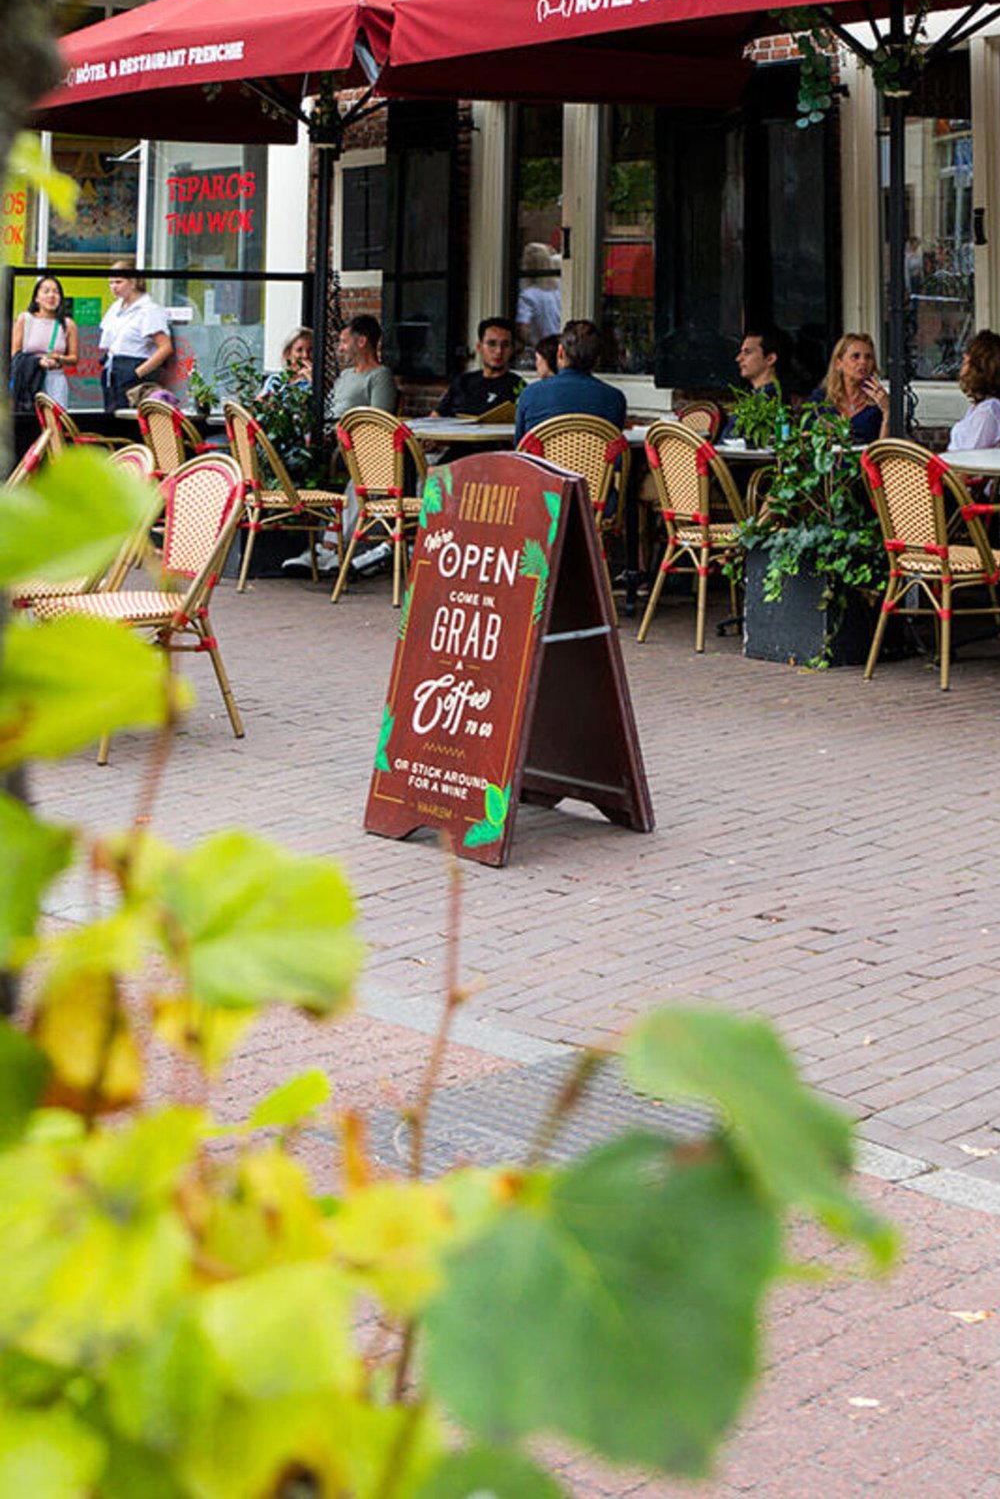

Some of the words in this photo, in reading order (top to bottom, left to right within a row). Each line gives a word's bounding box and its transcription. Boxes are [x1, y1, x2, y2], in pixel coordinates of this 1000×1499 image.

[119, 49, 187, 76] RESTAURANT
[188, 41, 245, 65] FRENCHIE
[166, 171, 256, 203] TEPAROS
[165, 212, 205, 236] THAI
[206, 209, 255, 235] WOK
[438, 542, 520, 587] OPEN
[450, 591, 480, 606] COME
[482, 596, 496, 608] IN
[431, 606, 502, 661] GRAB
[455, 660, 464, 671] A
[412, 674, 492, 736] Coffee
[464, 719, 479, 736] TO
[479, 721, 494, 738] GO
[394, 758, 410, 771] OR
[411, 762, 442, 779] STICK
[443, 770, 489, 791] AROUND
[408, 775, 430, 790] FOR
[431, 781, 440, 793] A
[441, 782, 469, 800] WINE
